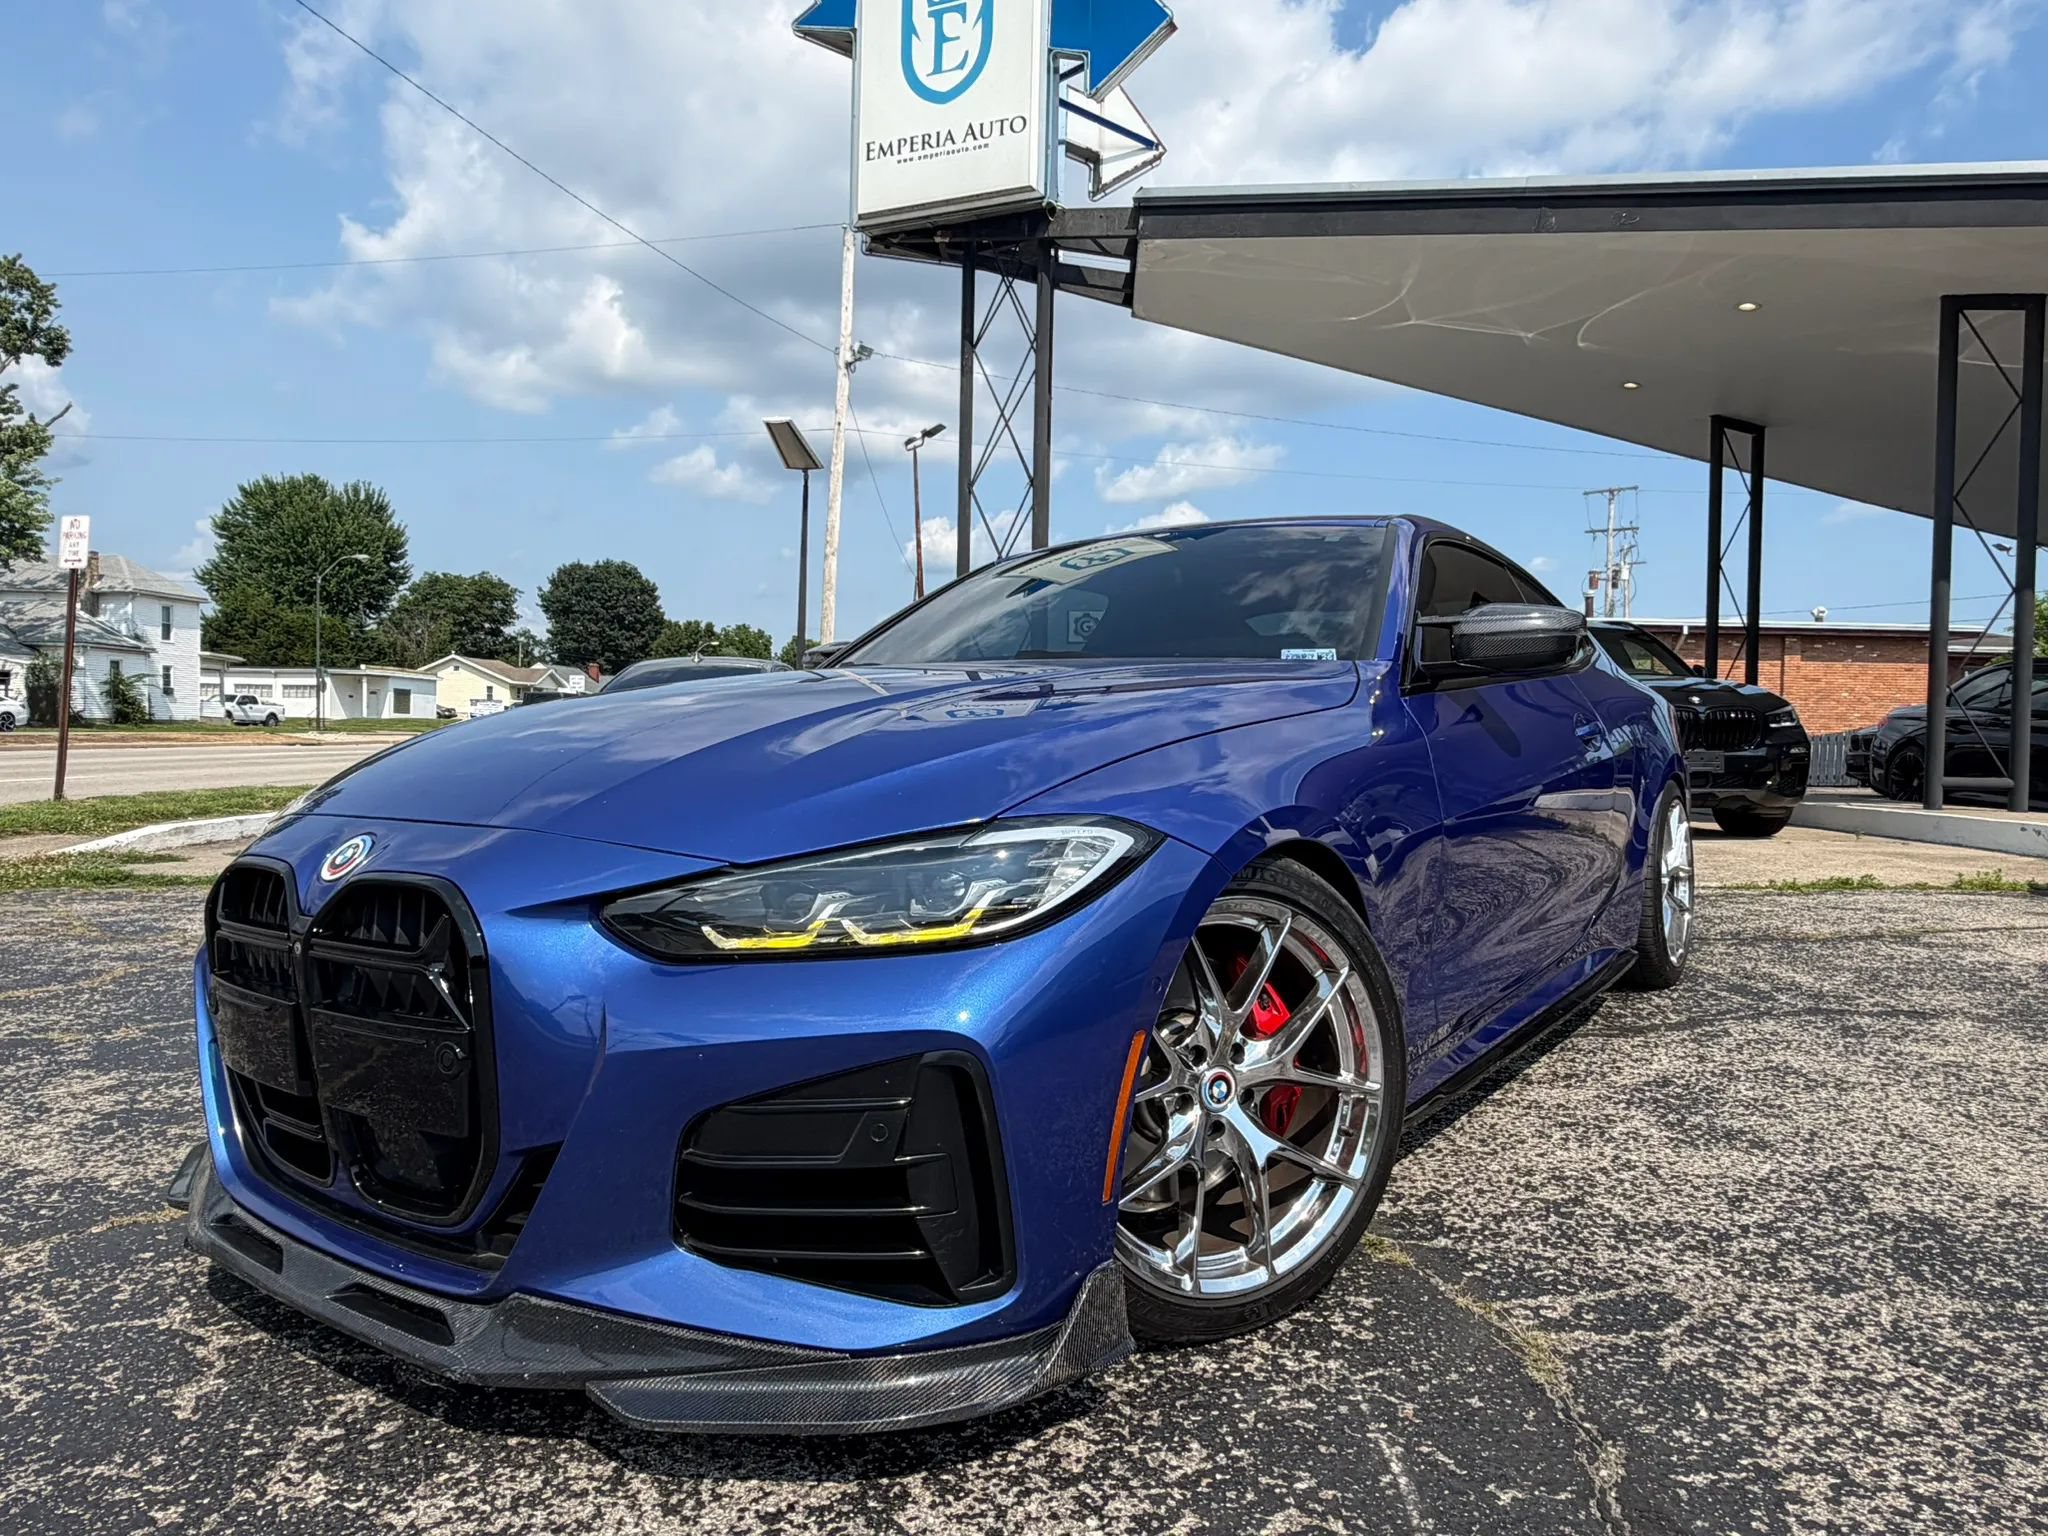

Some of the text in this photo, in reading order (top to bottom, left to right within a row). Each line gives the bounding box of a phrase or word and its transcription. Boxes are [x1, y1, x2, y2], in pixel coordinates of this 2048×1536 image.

[865, 115, 1027, 161] EMPERIA AUTO
[897, 142, 990, 164] www.emperiaauto.com
[70, 520, 80, 530] NO
[63, 531, 87, 540] PARKING
